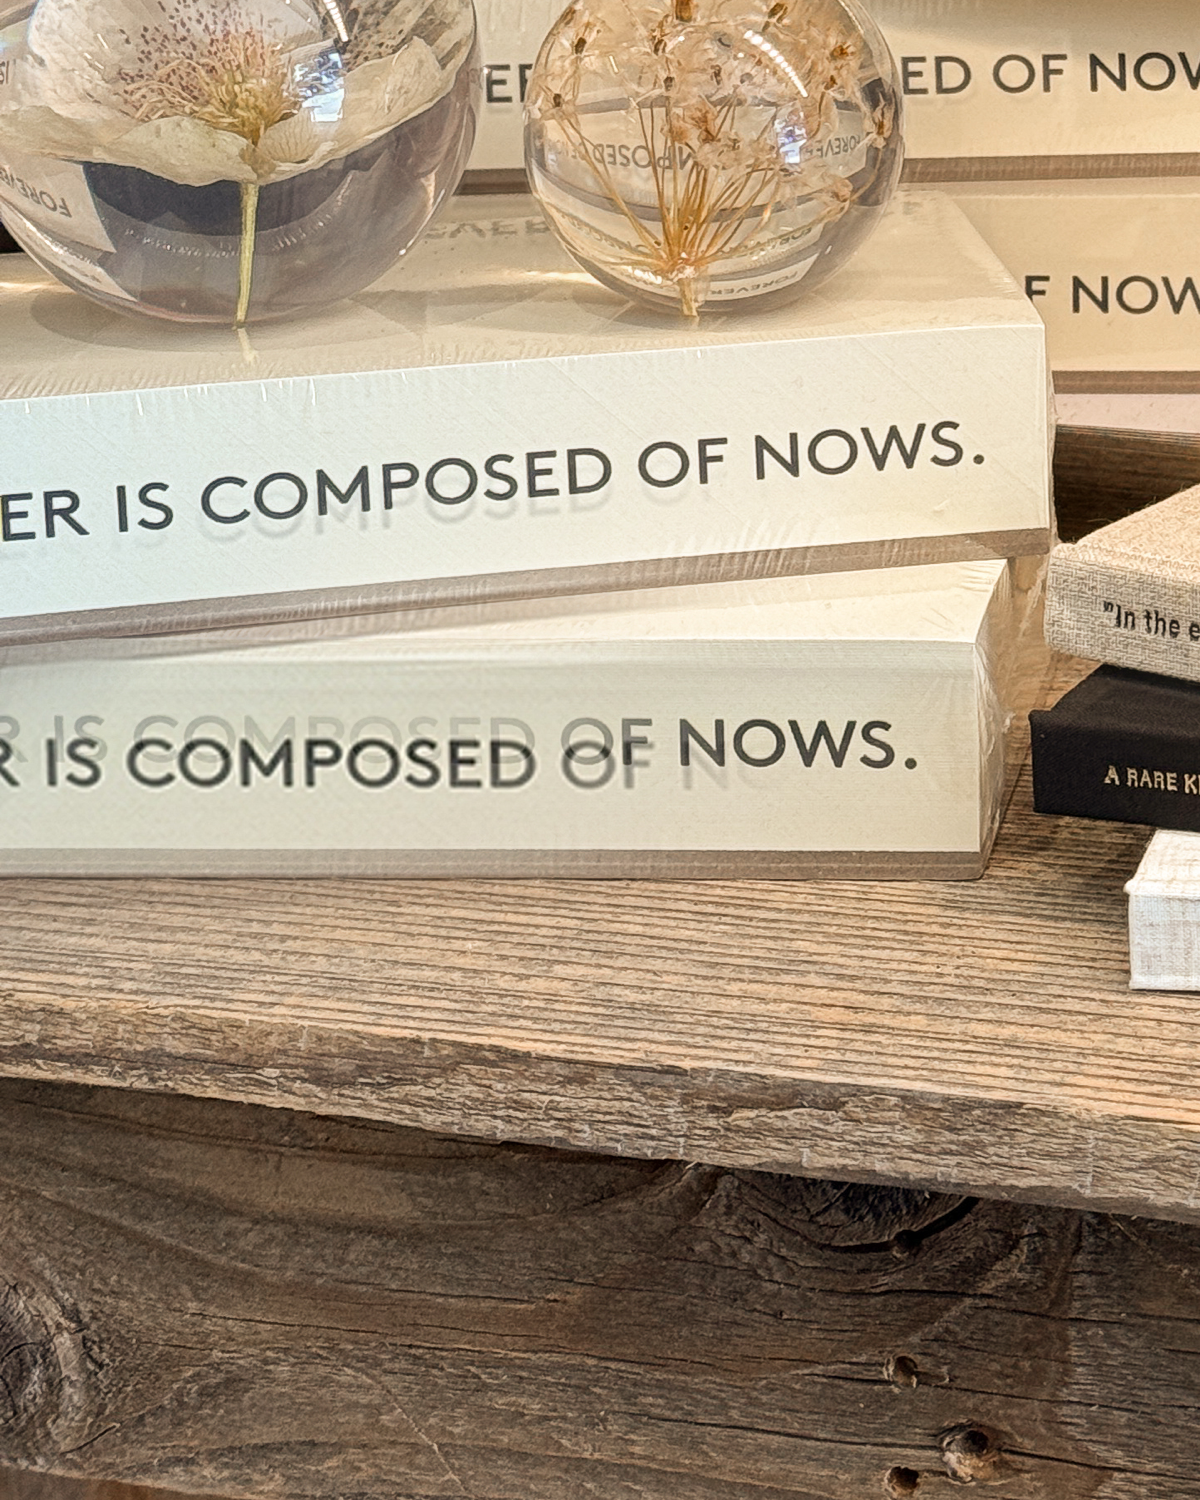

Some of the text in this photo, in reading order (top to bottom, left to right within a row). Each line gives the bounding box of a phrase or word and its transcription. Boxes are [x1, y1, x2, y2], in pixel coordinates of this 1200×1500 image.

[992, 53, 1068, 94] OF
[116, 482, 174, 533] IS
[200, 447, 612, 525] COMPOSED
[637, 437, 728, 488] OF
[754, 420, 985, 481] NOWS.
[1102, 601, 1136, 630] "In
[1144, 609, 1181, 638] the
[46, 737, 101, 788] IS
[126, 737, 536, 789] COMPOSED
[561, 719, 654, 789] OF
[679, 718, 918, 770] NOWS.
[1103, 765, 1120, 786] A
[1126, 767, 1177, 792] RARE
